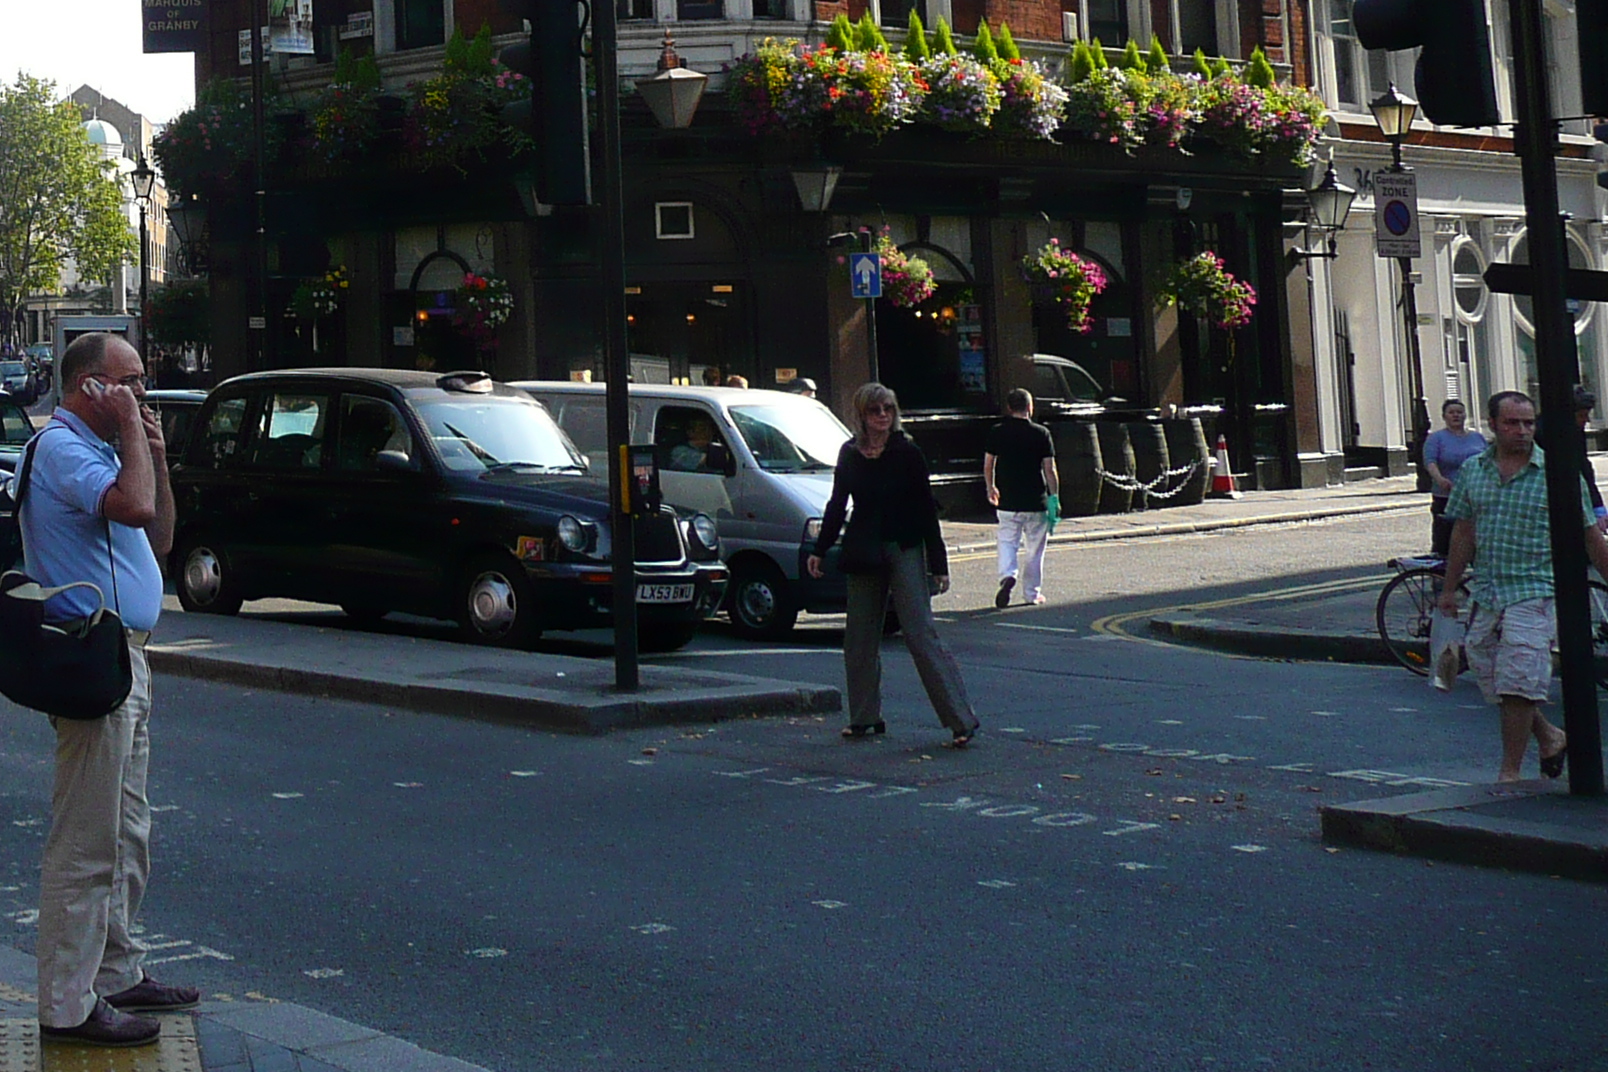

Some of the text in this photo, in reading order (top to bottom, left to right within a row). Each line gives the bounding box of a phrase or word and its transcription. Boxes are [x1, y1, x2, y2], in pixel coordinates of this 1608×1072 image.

[167, 9, 180, 19] OF
[149, 20, 199, 31] GRANBY
[1382, 187, 1409, 197] ZONE
[640, 585, 672, 600] LX53
